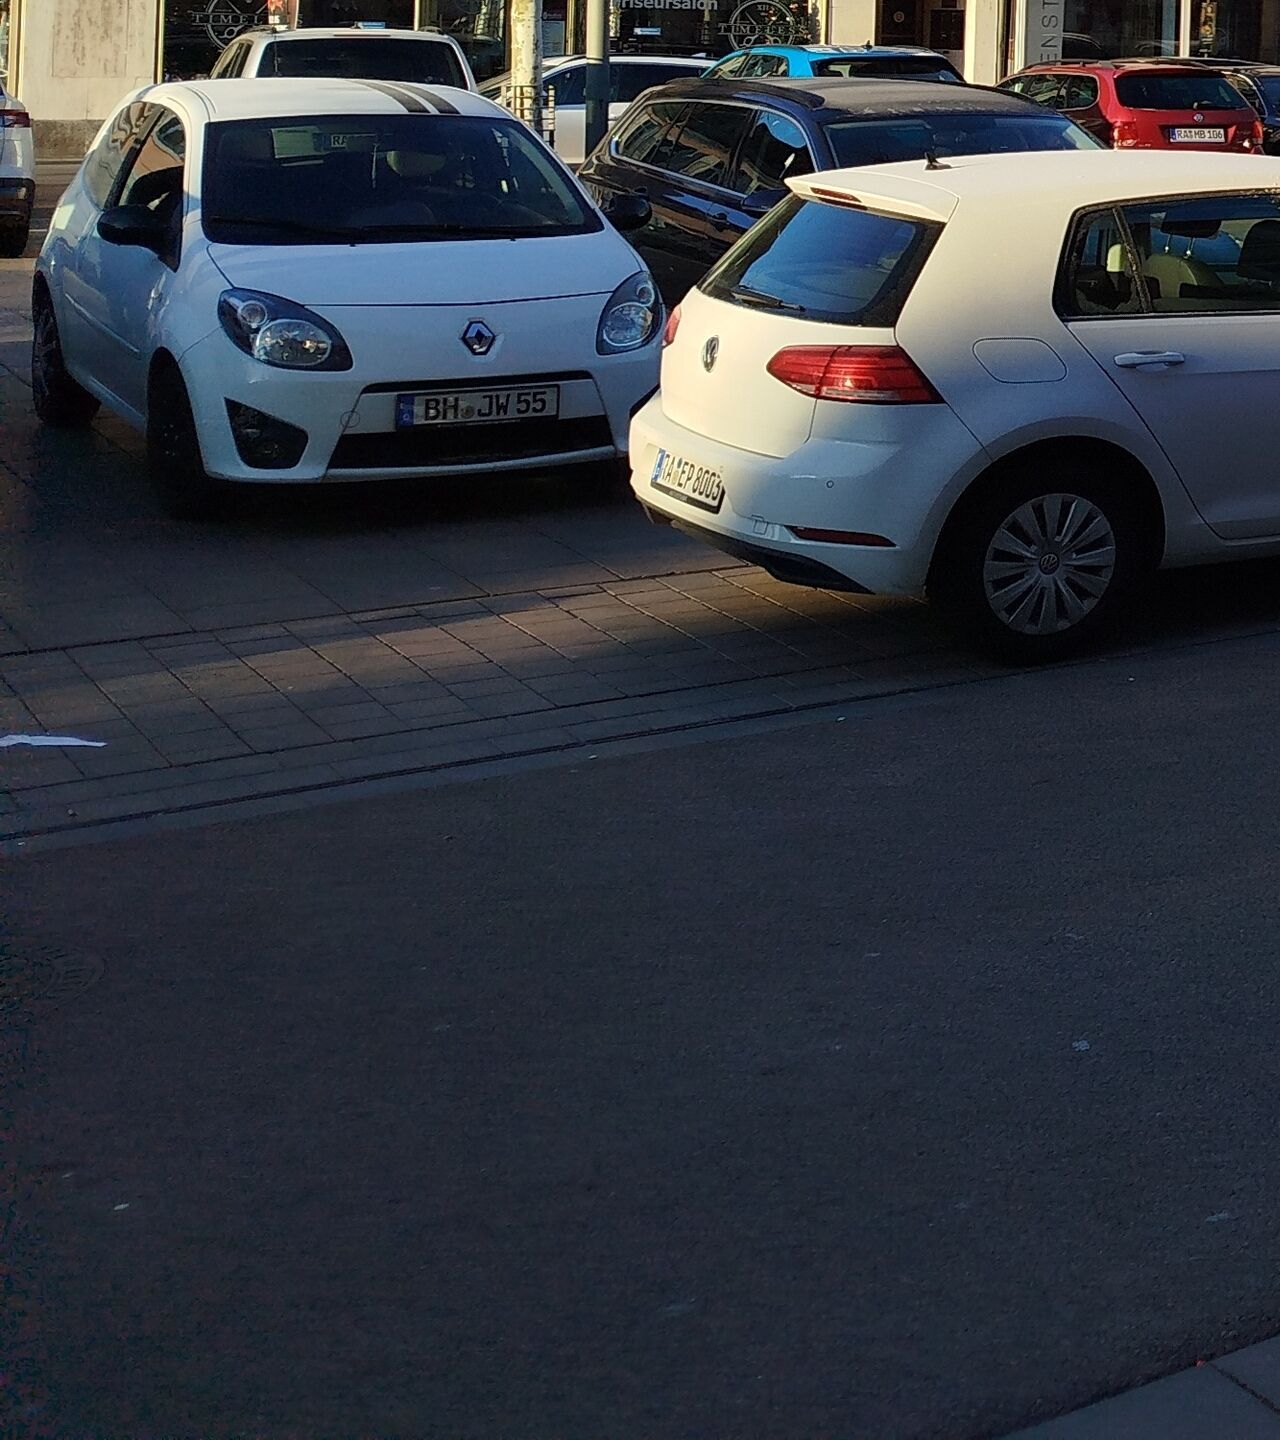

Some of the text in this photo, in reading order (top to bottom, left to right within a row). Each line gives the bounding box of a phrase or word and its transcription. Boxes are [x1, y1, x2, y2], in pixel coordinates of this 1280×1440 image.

[424, 391, 547, 421] BH JW 55
[677, 461, 696, 490] EP
